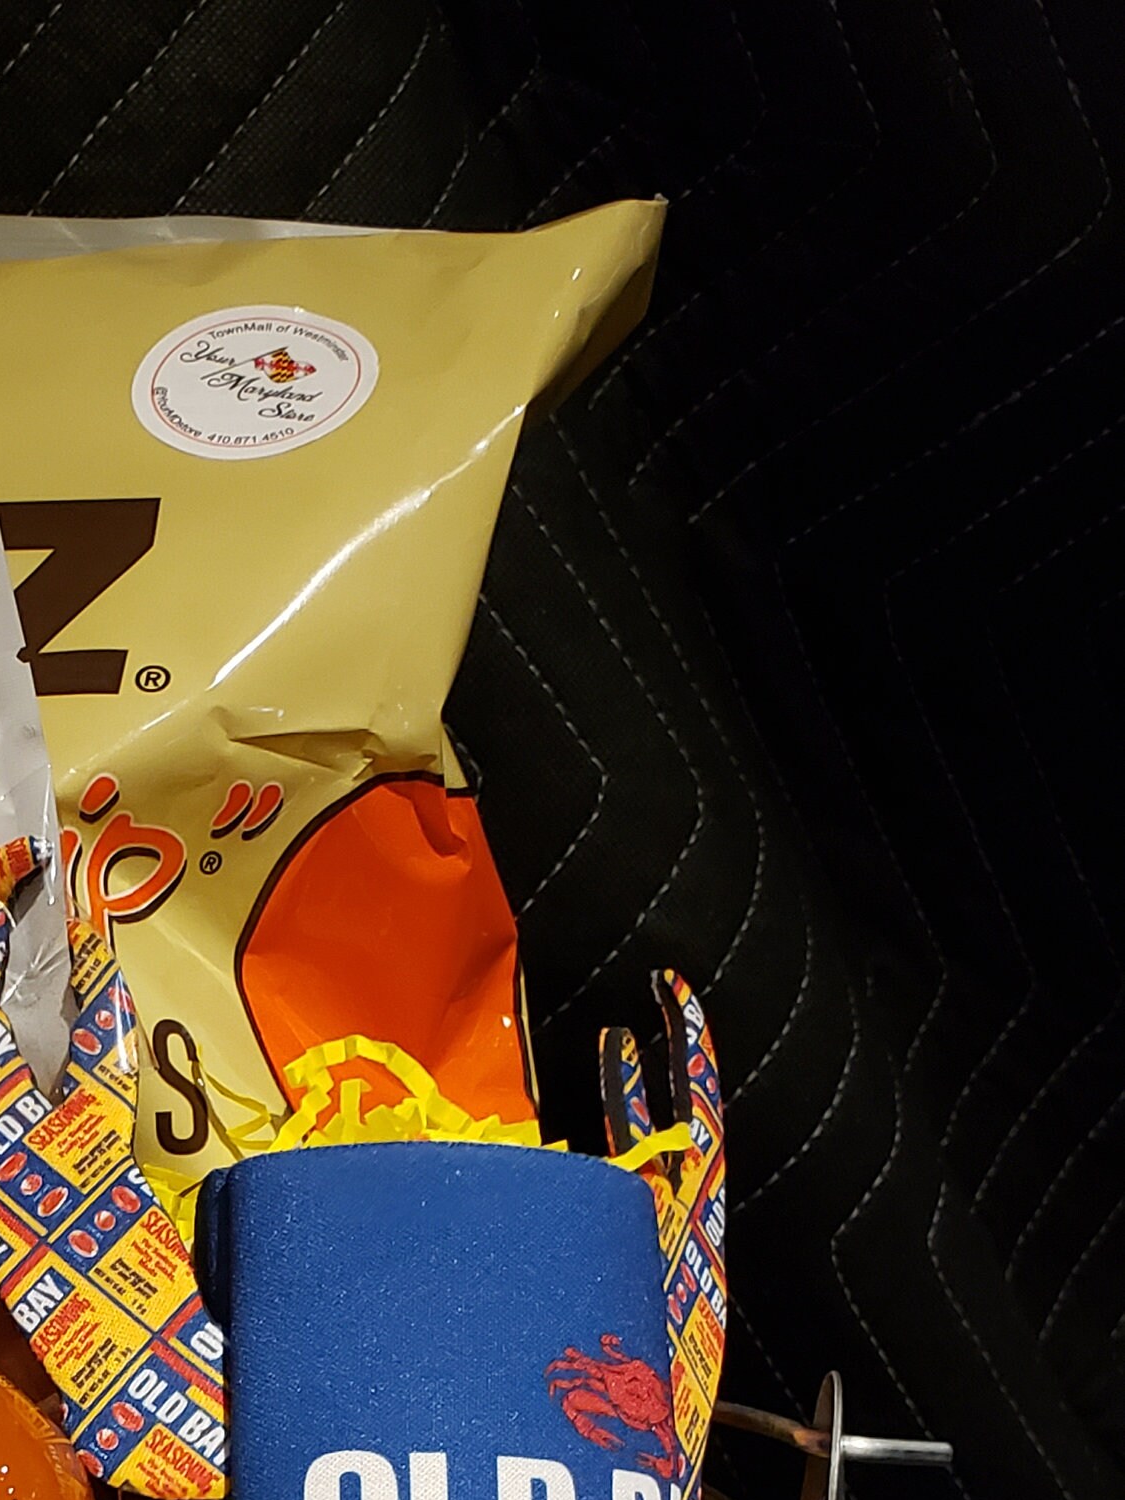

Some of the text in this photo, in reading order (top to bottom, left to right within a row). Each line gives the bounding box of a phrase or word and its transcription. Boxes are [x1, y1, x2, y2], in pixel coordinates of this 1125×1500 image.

[208, 322, 272, 340] TownMall
[276, 324, 291, 334] of
[179, 340, 236, 367] Your
[207, 372, 324, 404] Maryland
[258, 402, 315, 423] Store
[11, 1273, 65, 1333] BAY
[127, 1368, 188, 1424] OLD
